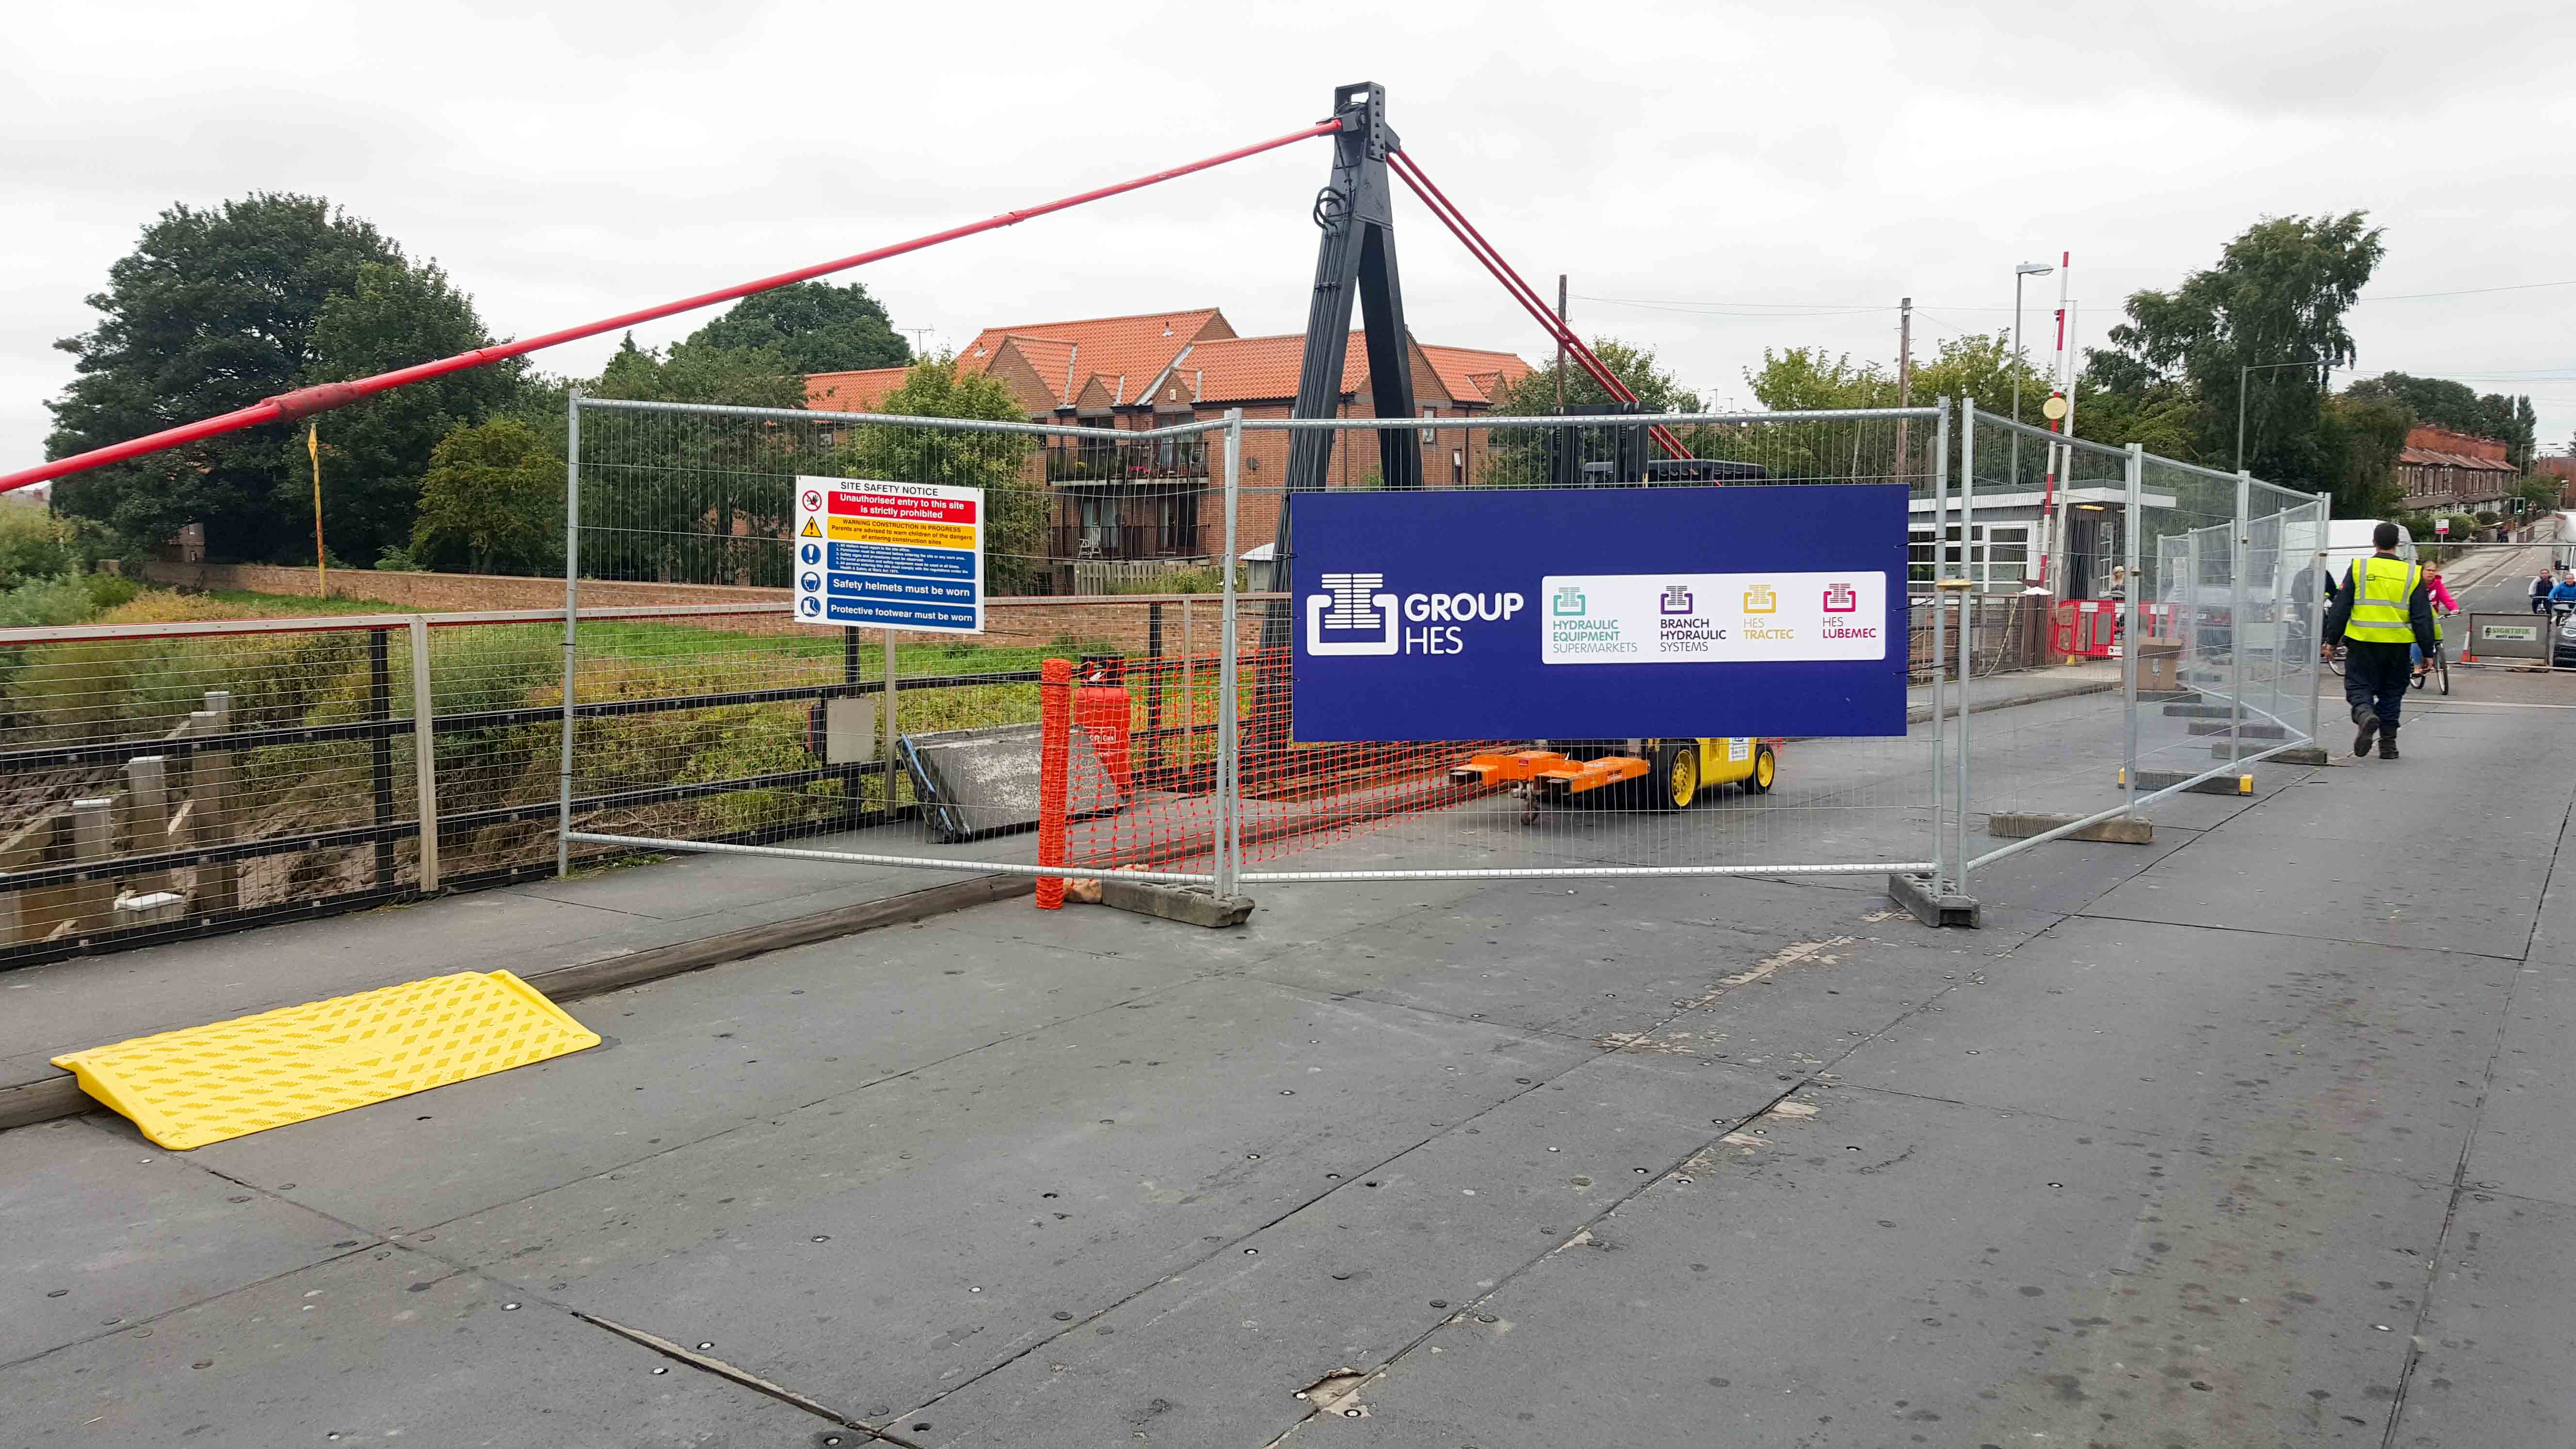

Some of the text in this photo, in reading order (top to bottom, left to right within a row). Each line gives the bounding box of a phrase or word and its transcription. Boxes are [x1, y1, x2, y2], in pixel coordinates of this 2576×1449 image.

[841, 482, 939, 496] SITE SAFETY NOTICE
[840, 493, 964, 510] Unauthorised entry to this site
[861, 505, 943, 518] is strictly prohibited
[872, 521, 918, 529] CONSTRUCTION
[833, 579, 970, 596] Safety helmets must be worn
[831, 604, 873, 615] Protective
[875, 608, 912, 617] footwear
[915, 612, 936, 620] must
[938, 612, 949, 620] be
[1404, 593, 1524, 621] GROUP
[1553, 619, 1618, 630] HYDRAULIC
[1660, 618, 1709, 628] BRANCH
[1743, 617, 1765, 628] HES
[1823, 616, 1843, 627] HES
[1553, 631, 1620, 642] EQUIPMENT
[1660, 629, 1726, 640] HYDRAULIC
[1743, 629, 1794, 640] TRACTEC
[1823, 628, 1877, 638] LUBEMEC
[1406, 626, 1463, 655] HES
[1553, 642, 1638, 653] SUPERMARKETS
[1660, 642, 1708, 652] SYSTEMS
